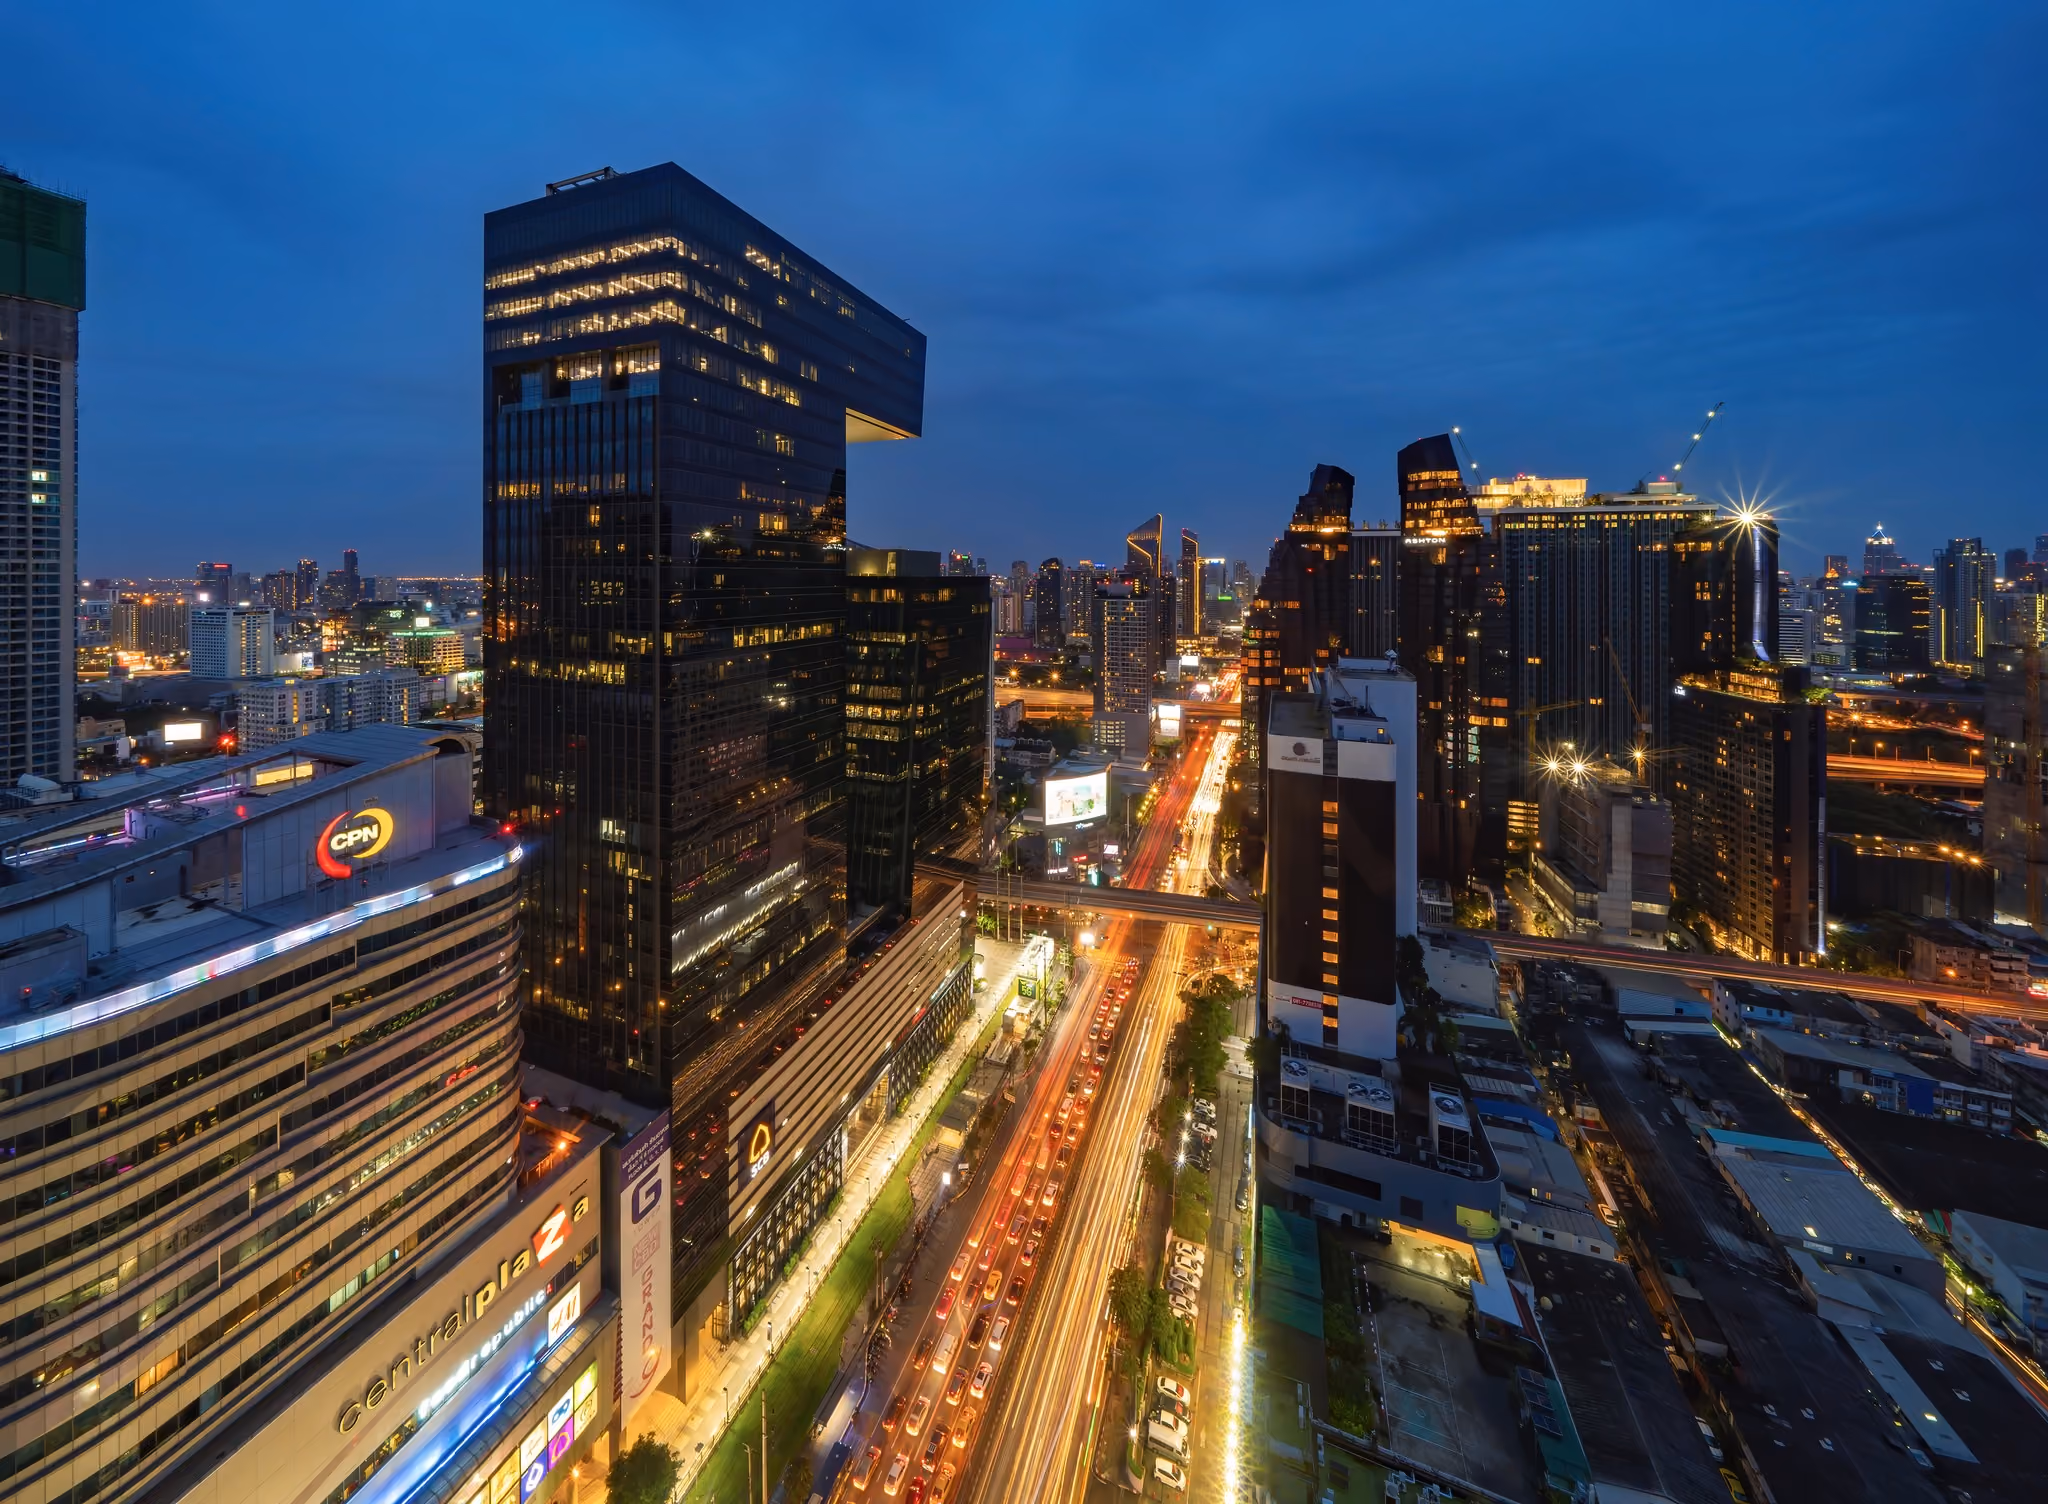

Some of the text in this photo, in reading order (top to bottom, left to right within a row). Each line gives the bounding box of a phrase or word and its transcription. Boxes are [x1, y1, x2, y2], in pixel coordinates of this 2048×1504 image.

[330, 823, 379, 851] CPN
[751, 1150, 770, 1178] SCB
[641, 1264, 654, 1356] GRAND
